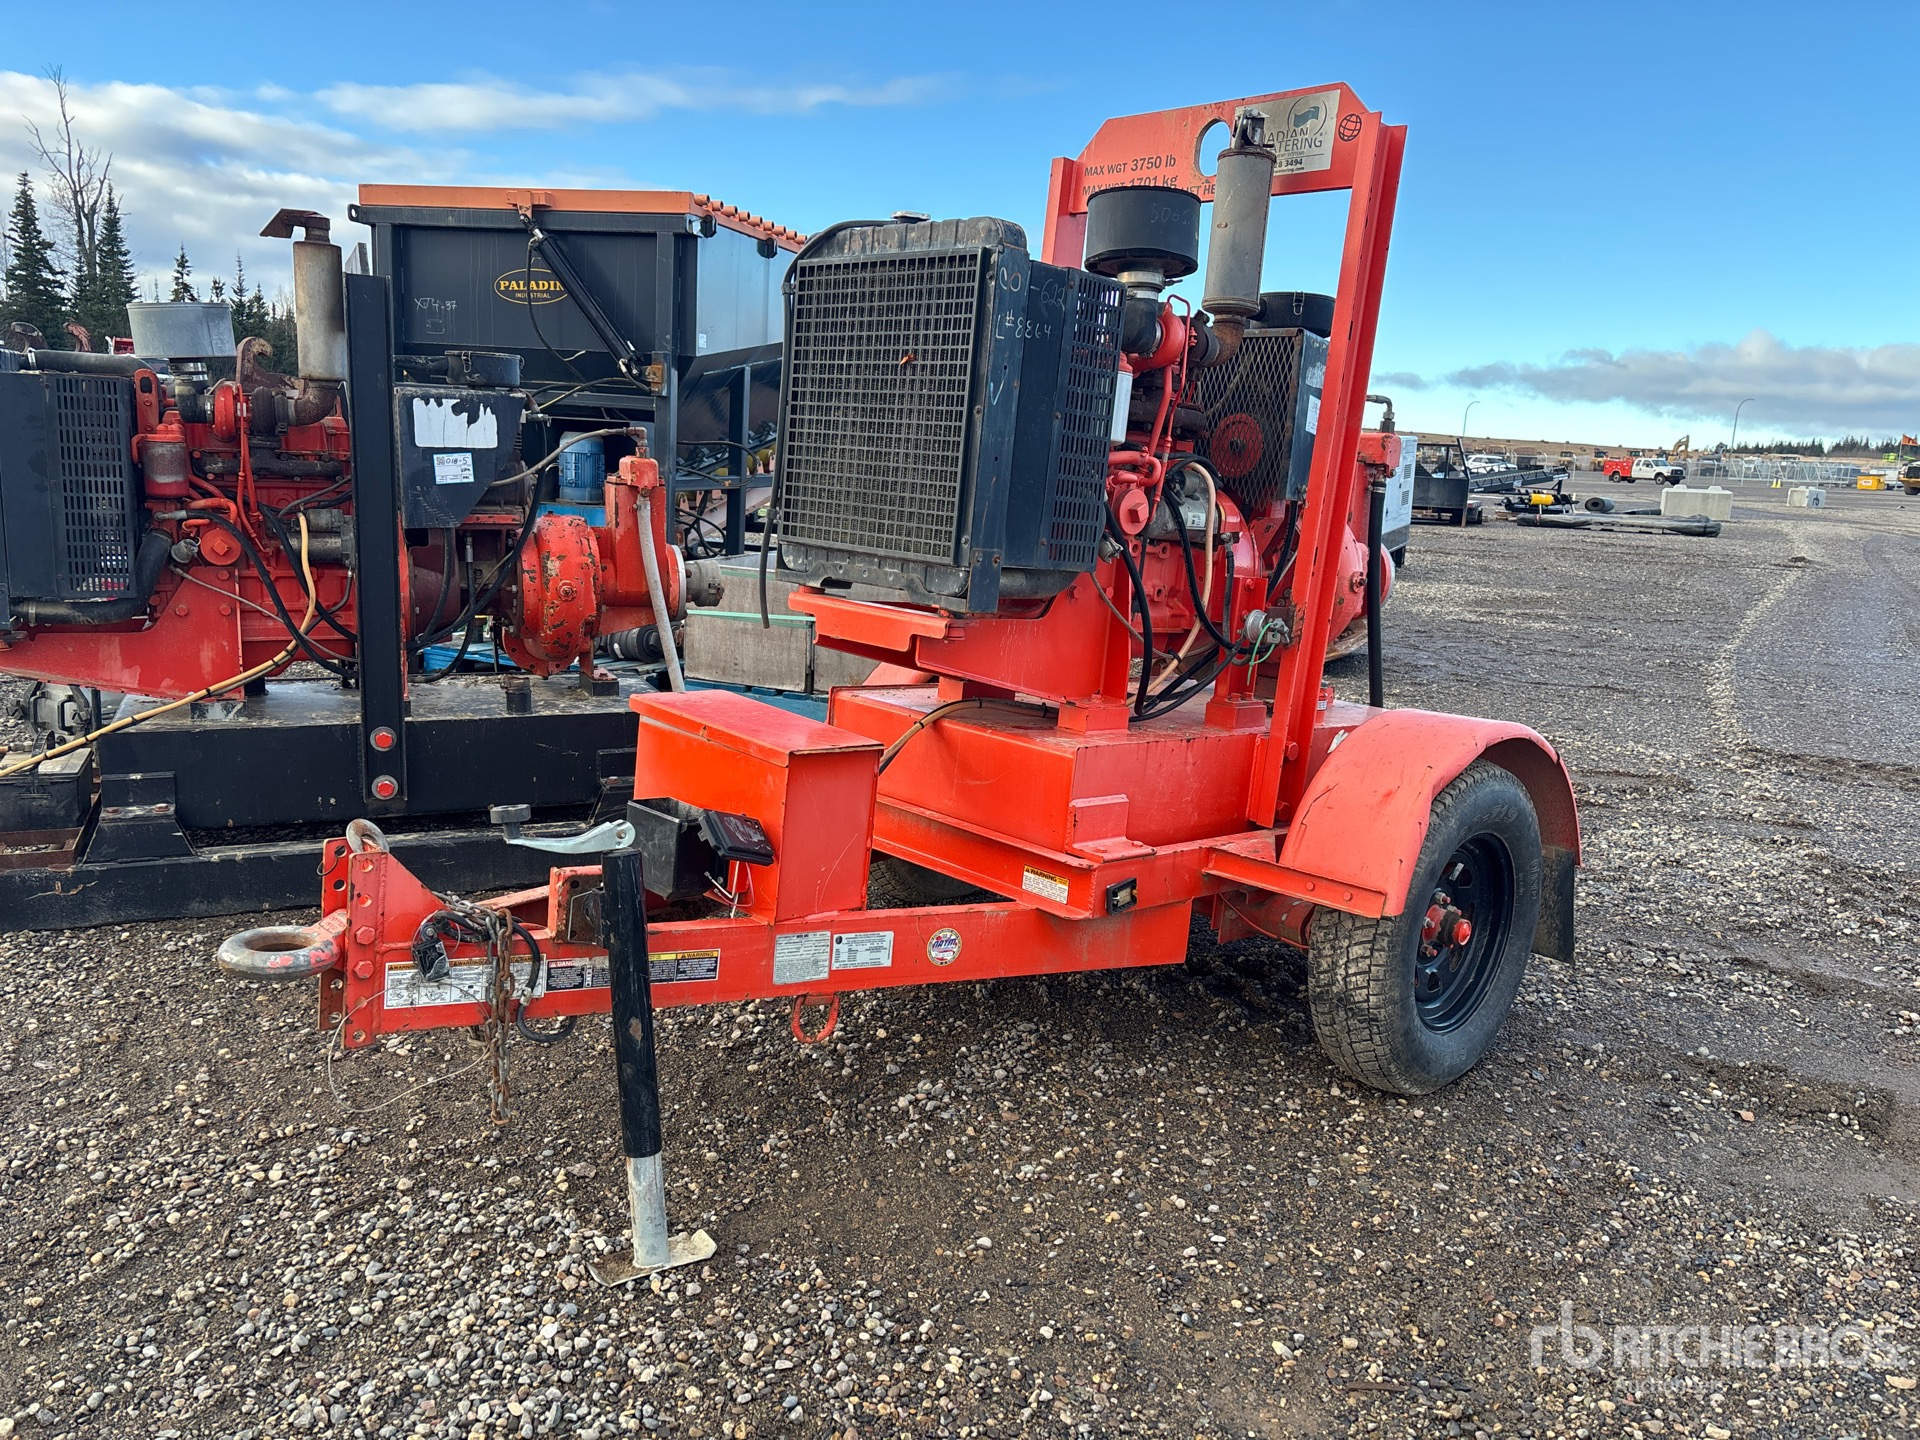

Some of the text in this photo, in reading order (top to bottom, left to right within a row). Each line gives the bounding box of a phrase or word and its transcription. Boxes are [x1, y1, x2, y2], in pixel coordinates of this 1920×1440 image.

[1084, 154, 1177, 177] MAX WGT 3750 lb
[1285, 158, 1303, 167] 3494
[1129, 175, 1158, 187] 1701
[1162, 175, 1178, 189] kg
[1030, 868, 1058, 882] WARNING
